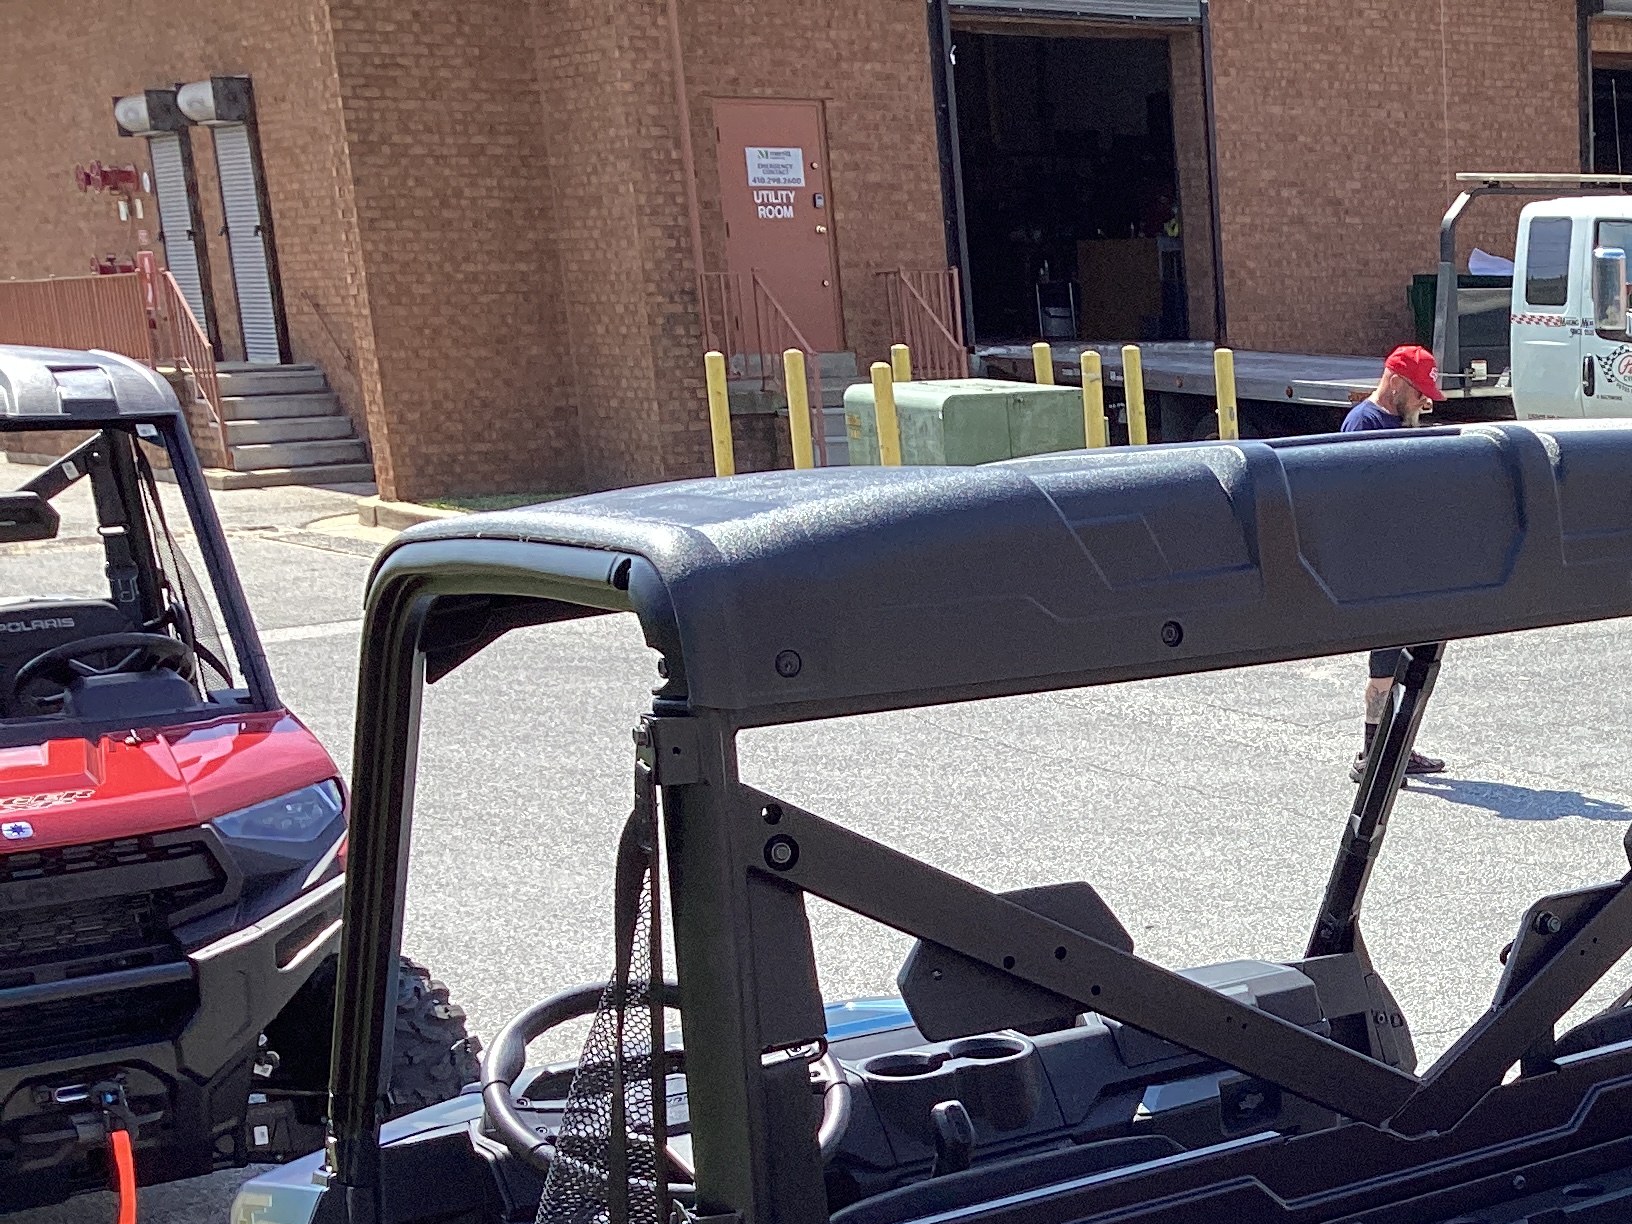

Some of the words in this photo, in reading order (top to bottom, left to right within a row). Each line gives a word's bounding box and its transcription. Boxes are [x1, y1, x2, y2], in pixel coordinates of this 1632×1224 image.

[753, 190, 795, 203] UTILITY
[757, 205, 795, 218] ROOM
[0, 617, 75, 633] POLARIS
